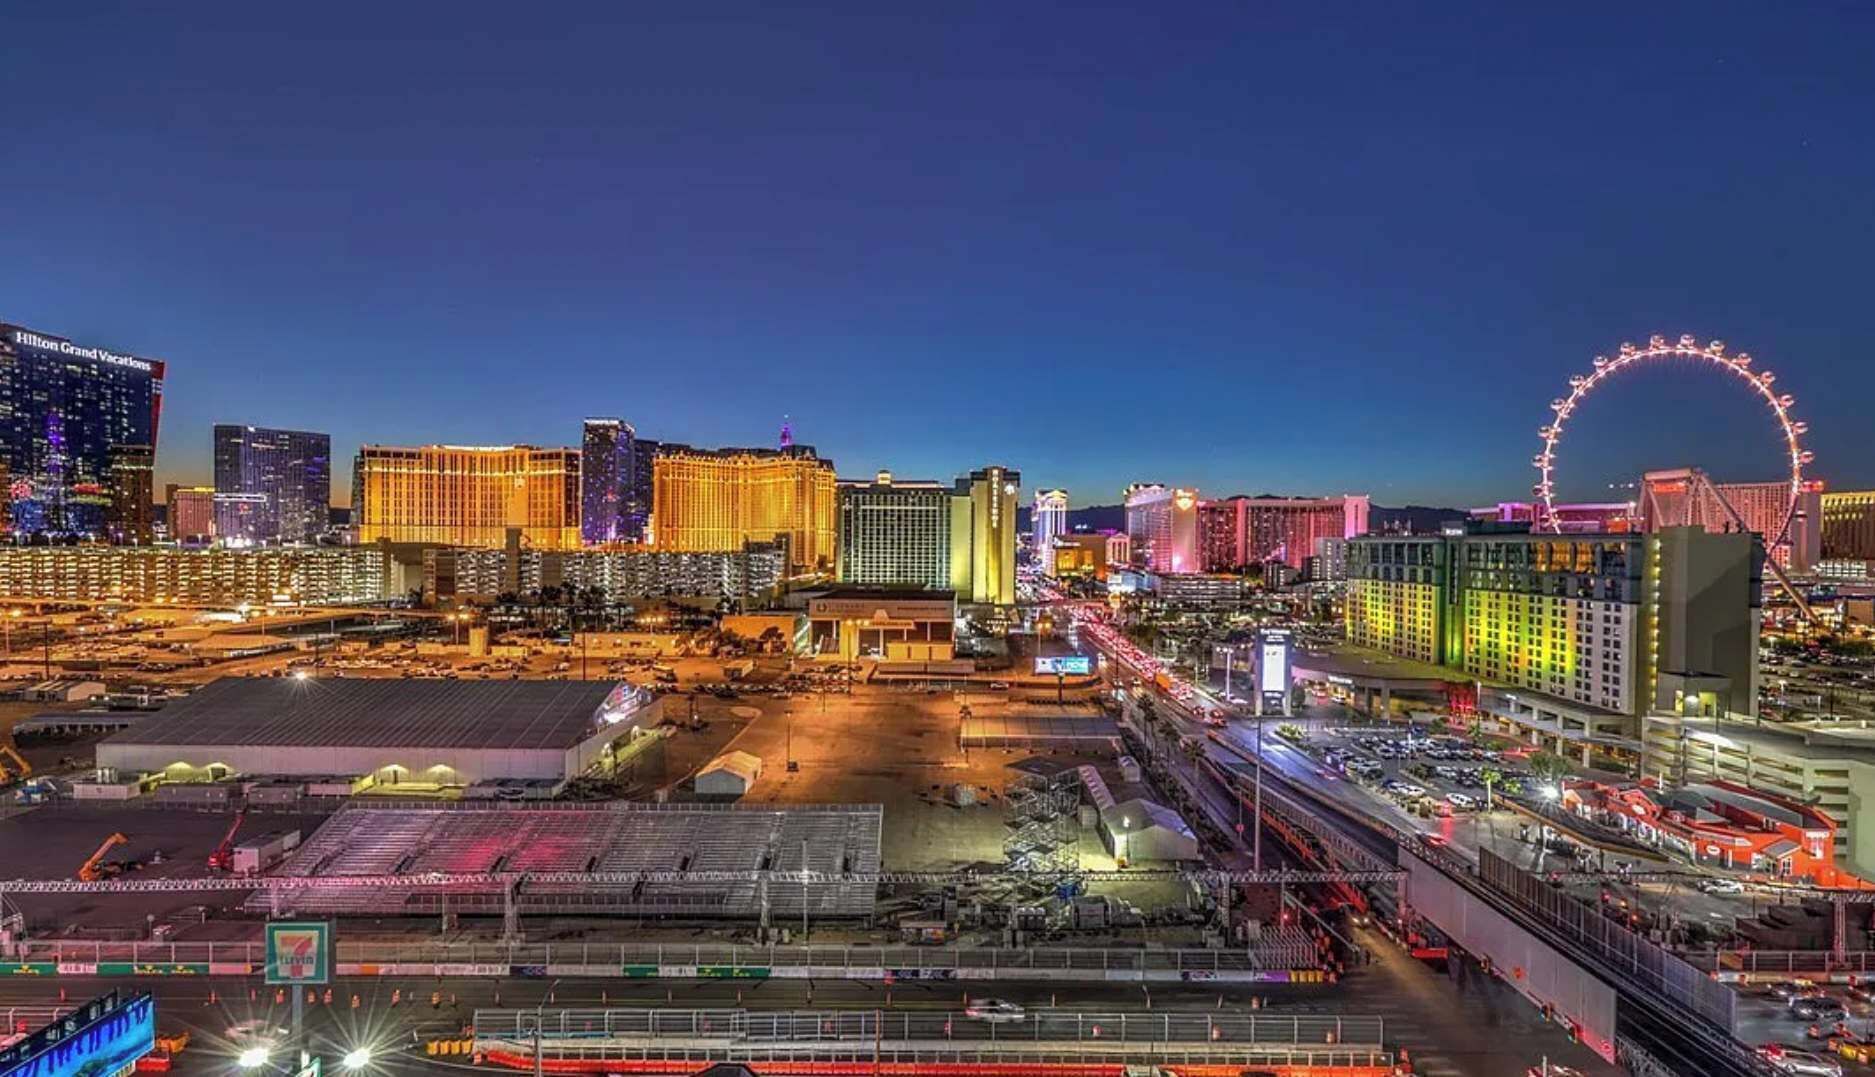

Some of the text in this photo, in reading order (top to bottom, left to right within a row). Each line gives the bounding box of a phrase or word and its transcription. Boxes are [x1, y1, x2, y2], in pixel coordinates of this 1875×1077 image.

[16, 331, 151, 371] Hilton Grand Vacations
